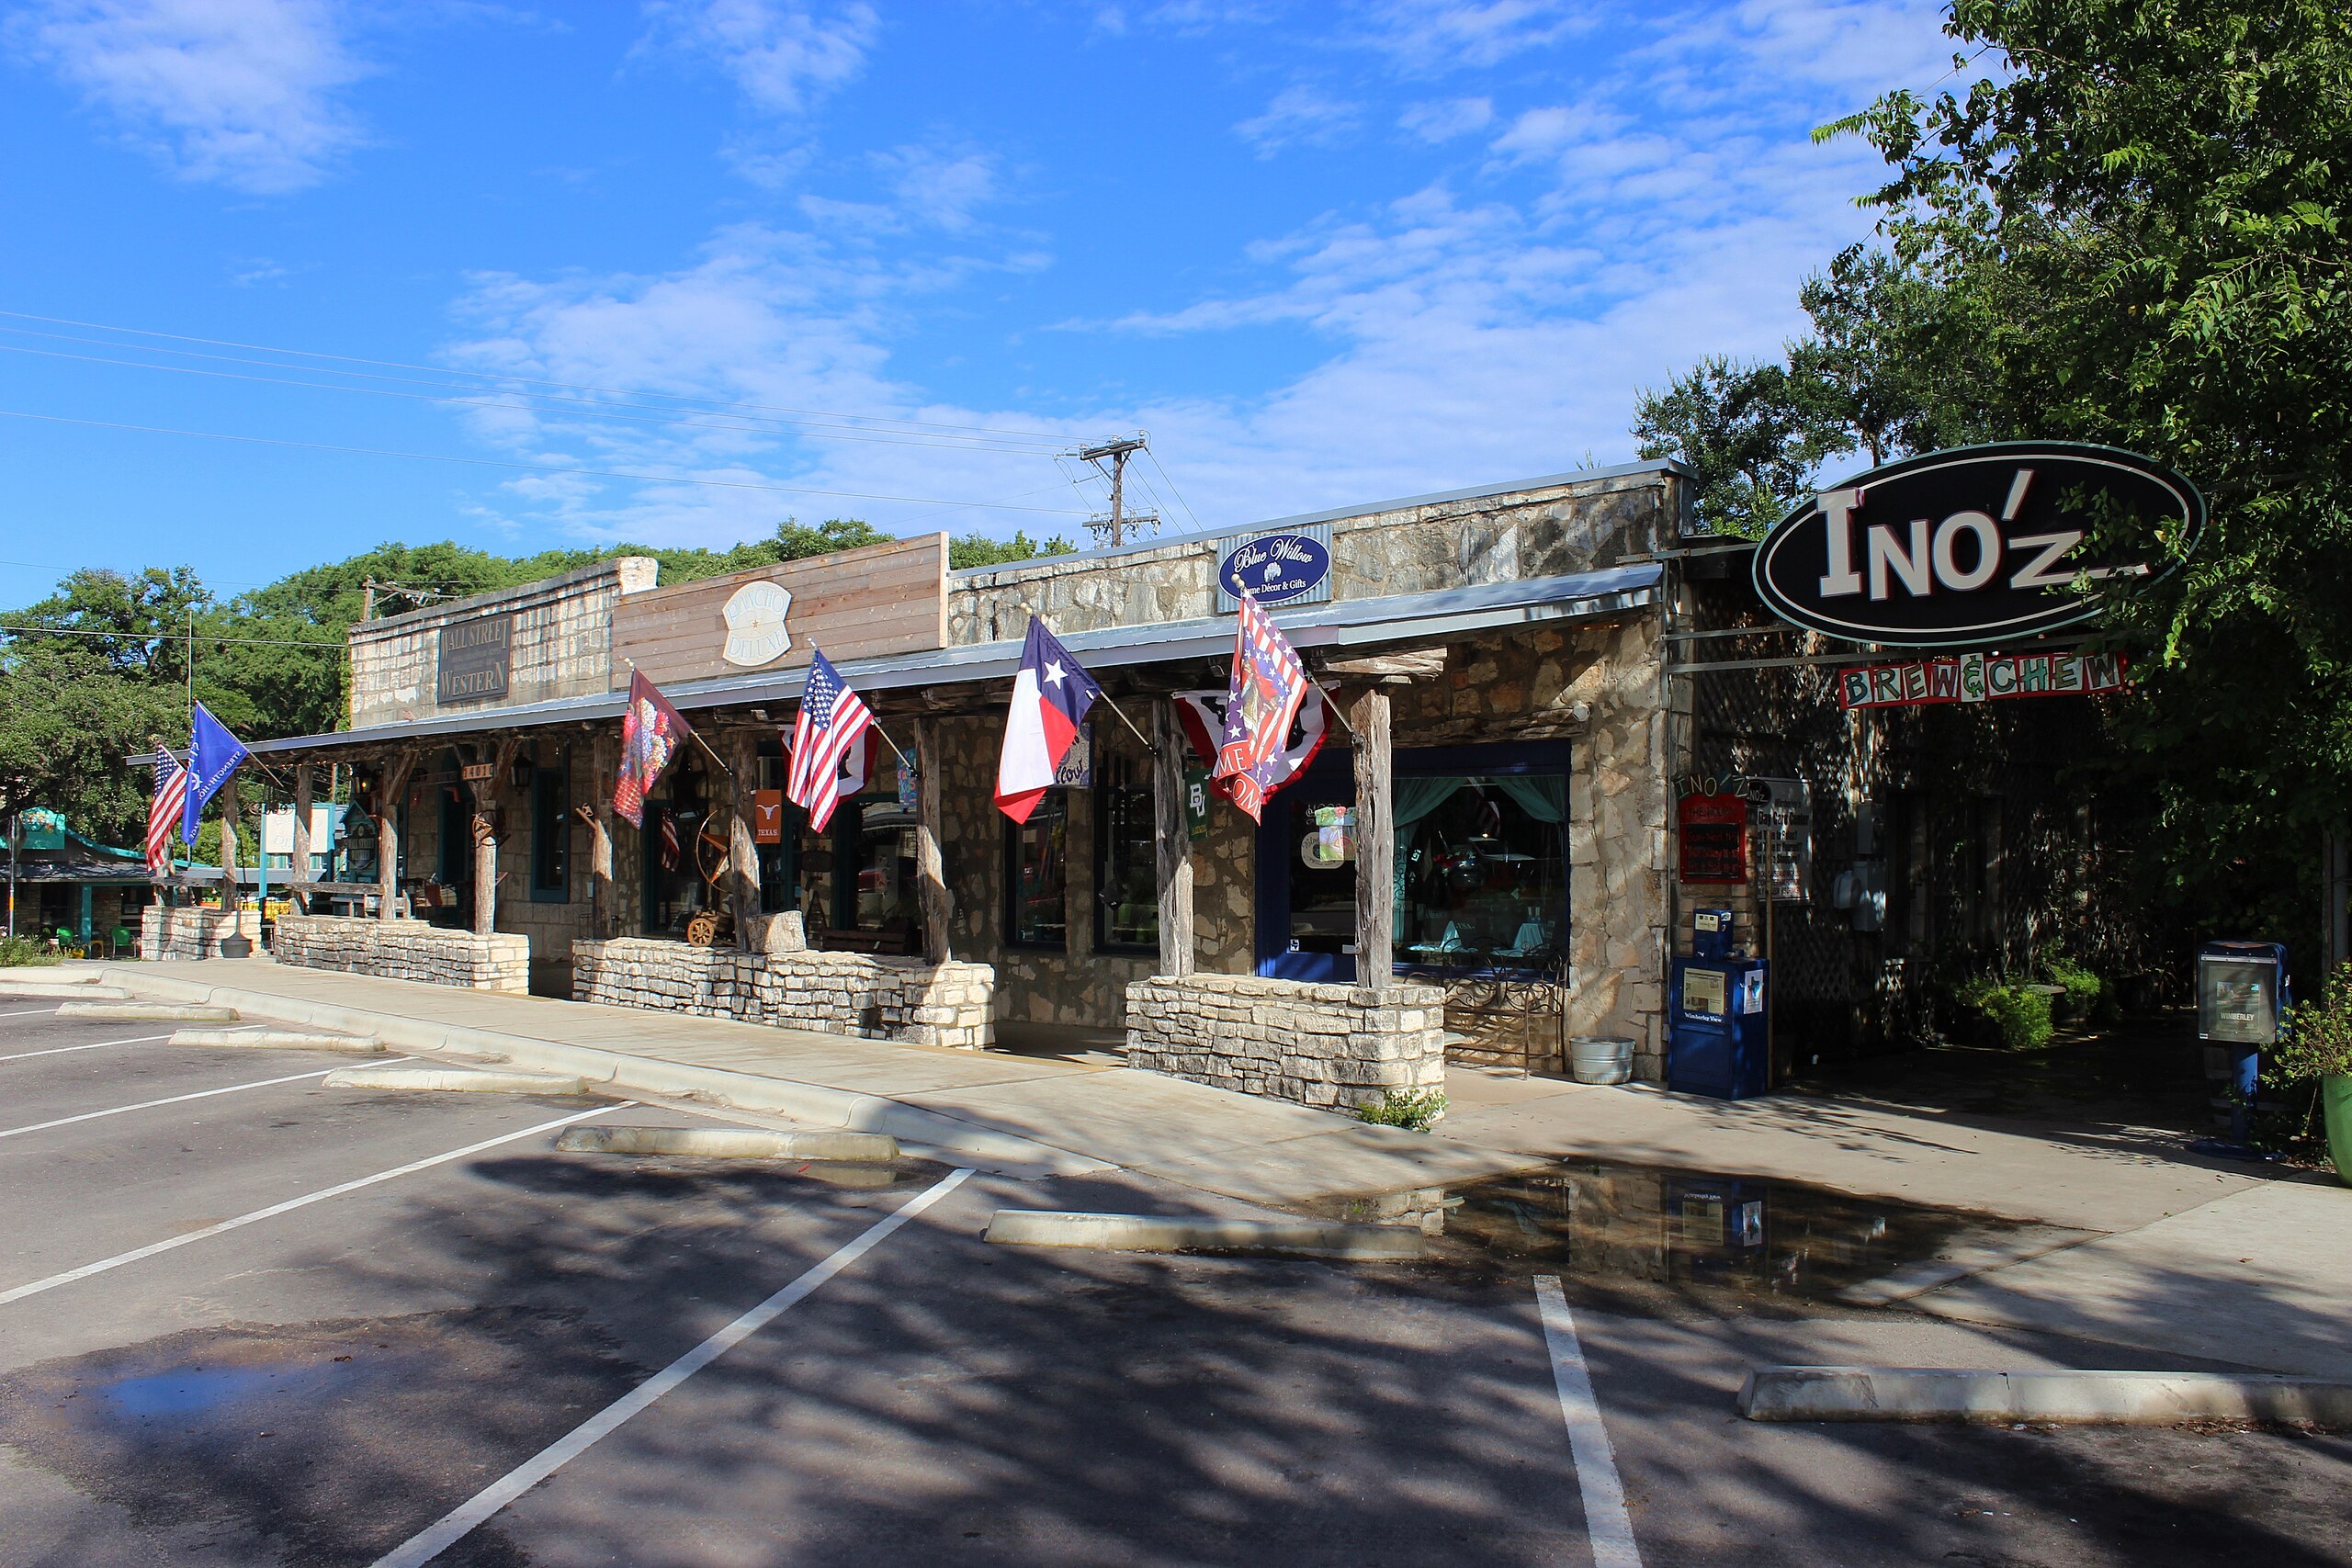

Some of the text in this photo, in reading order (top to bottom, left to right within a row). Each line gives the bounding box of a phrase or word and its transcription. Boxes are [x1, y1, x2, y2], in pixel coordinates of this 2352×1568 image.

[1234, 536, 1314, 572] Blue Willow
[1261, 581, 1281, 592] Décor
[1282, 581, 1289, 590] &
[1289, 578, 1306, 589] Gifts
[442, 628, 467, 660] WALL
[469, 618, 509, 649] STREET
[729, 627, 785, 659] DELUXE
[441, 660, 506, 698] WESTERN
[1758, 810, 1771, 826] Day
[1772, 810, 1789, 825] Care
[1684, 1011, 1723, 1022] Wimberley View
[2220, 1011, 2255, 1021] WIMBERLEY
